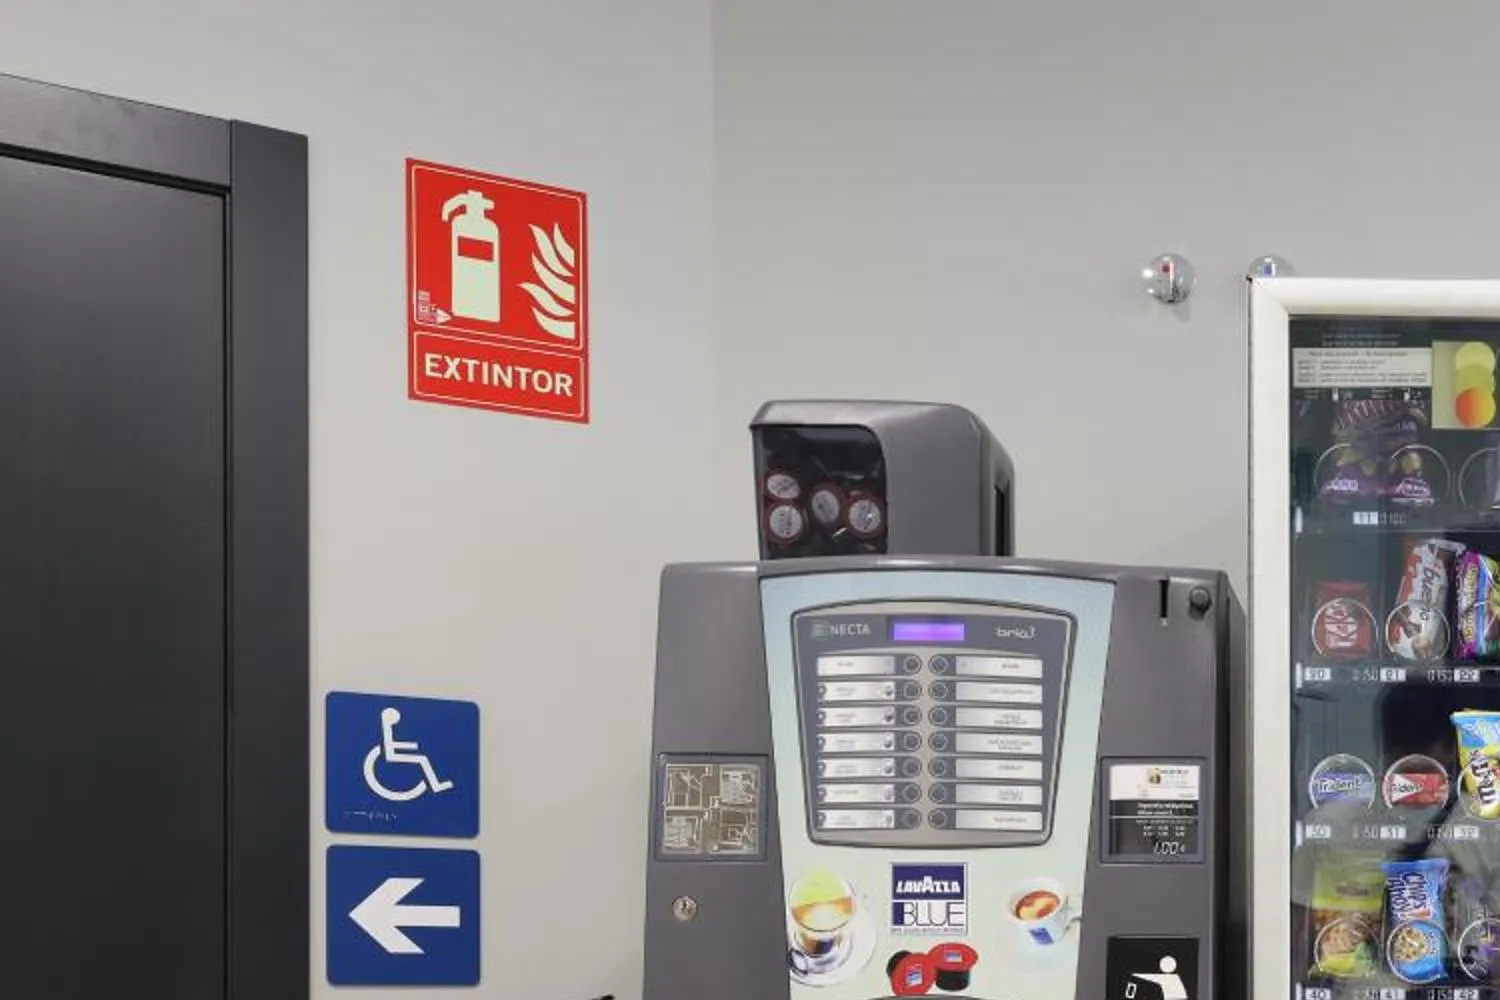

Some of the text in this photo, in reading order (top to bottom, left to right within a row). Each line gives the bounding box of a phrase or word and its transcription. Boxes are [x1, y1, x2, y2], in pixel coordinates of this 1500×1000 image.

[425, 352, 574, 397] EXTINTOR
[830, 623, 871, 637] NECTA
[892, 901, 965, 926] BLUE
